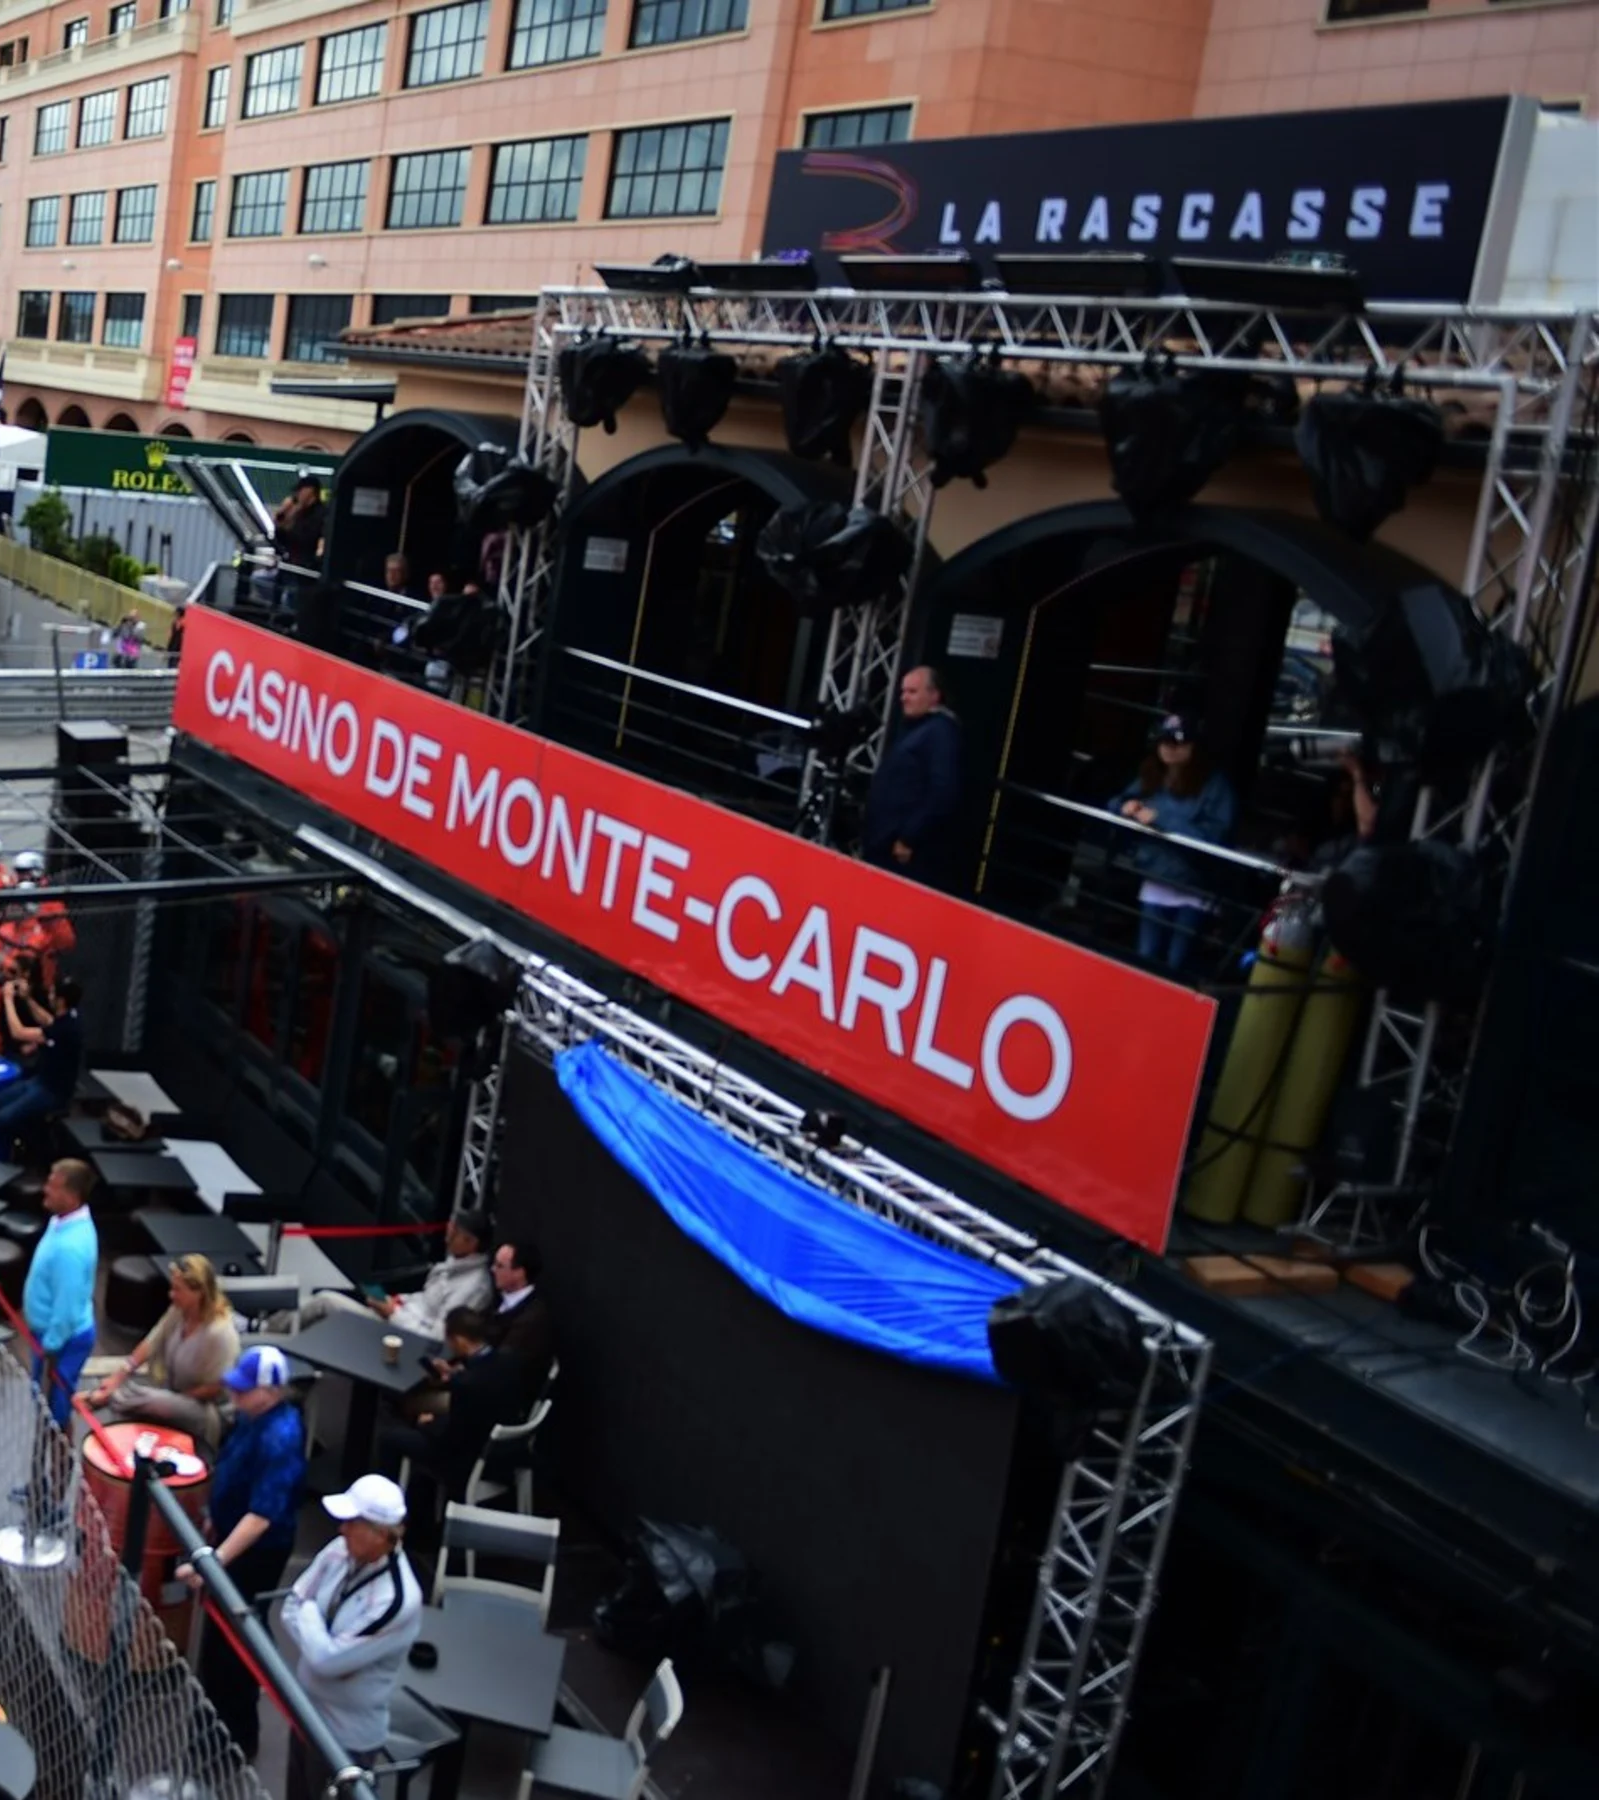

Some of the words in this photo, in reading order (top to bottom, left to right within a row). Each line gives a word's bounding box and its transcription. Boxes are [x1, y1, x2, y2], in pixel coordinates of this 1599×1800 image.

[938, 199, 1003, 245] LA
[1035, 183, 1451, 243] RASCASSE
[206, 647, 361, 778] CASINO
[364, 716, 443, 821] DE
[445, 751, 1073, 1122] MONTE-CARLO
